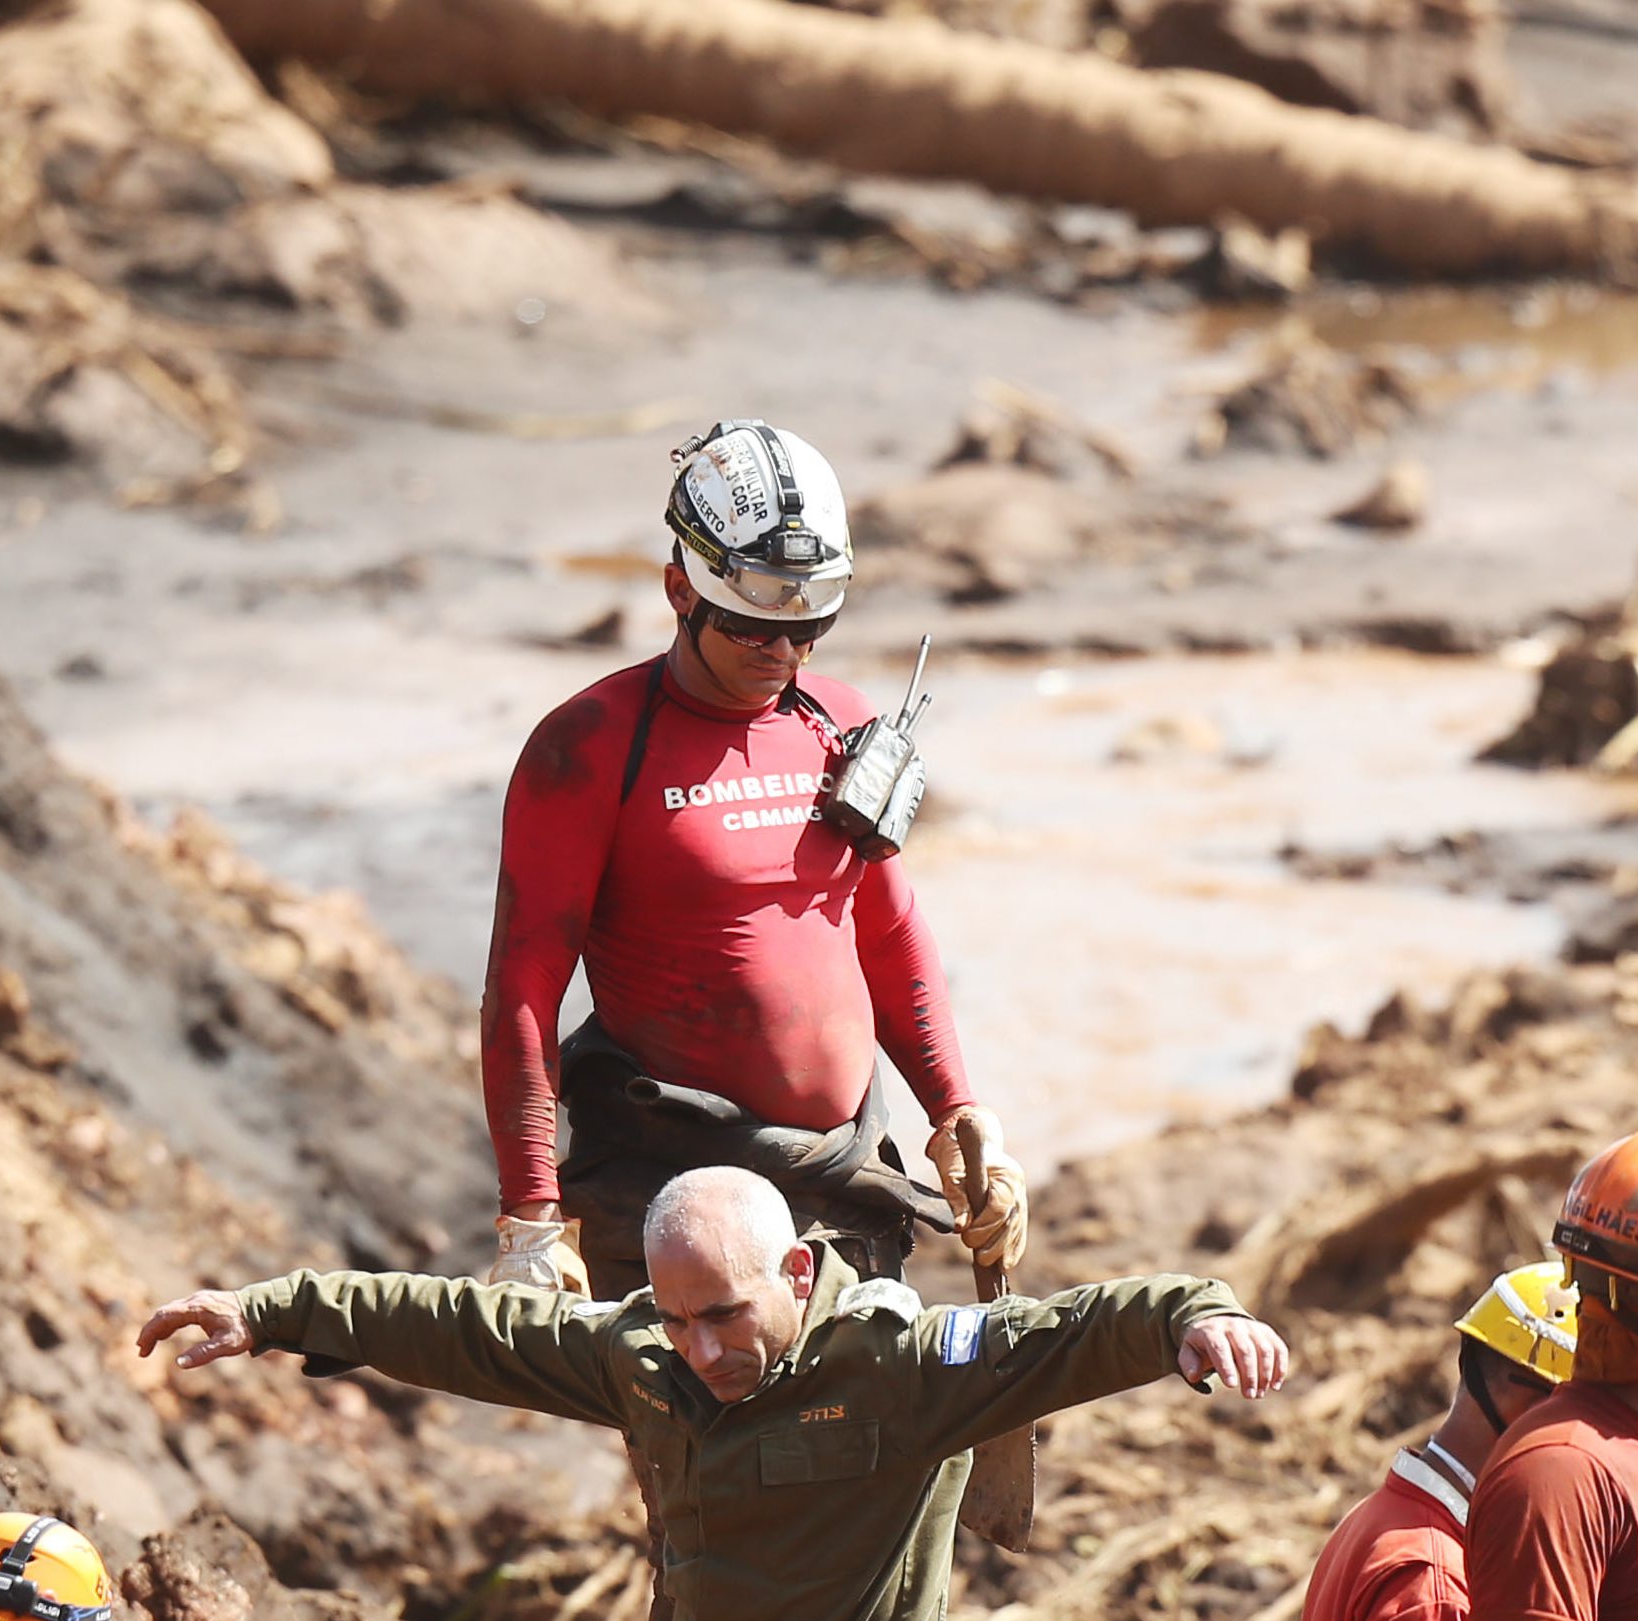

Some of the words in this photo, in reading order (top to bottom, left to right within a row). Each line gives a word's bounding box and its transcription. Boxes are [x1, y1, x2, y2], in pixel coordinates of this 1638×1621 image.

[731, 486, 750, 517] COB
[742, 466, 768, 523] MILITAR
[664, 772, 835, 810] BOMBEIRO
[722, 805, 823, 831] CBMMG
